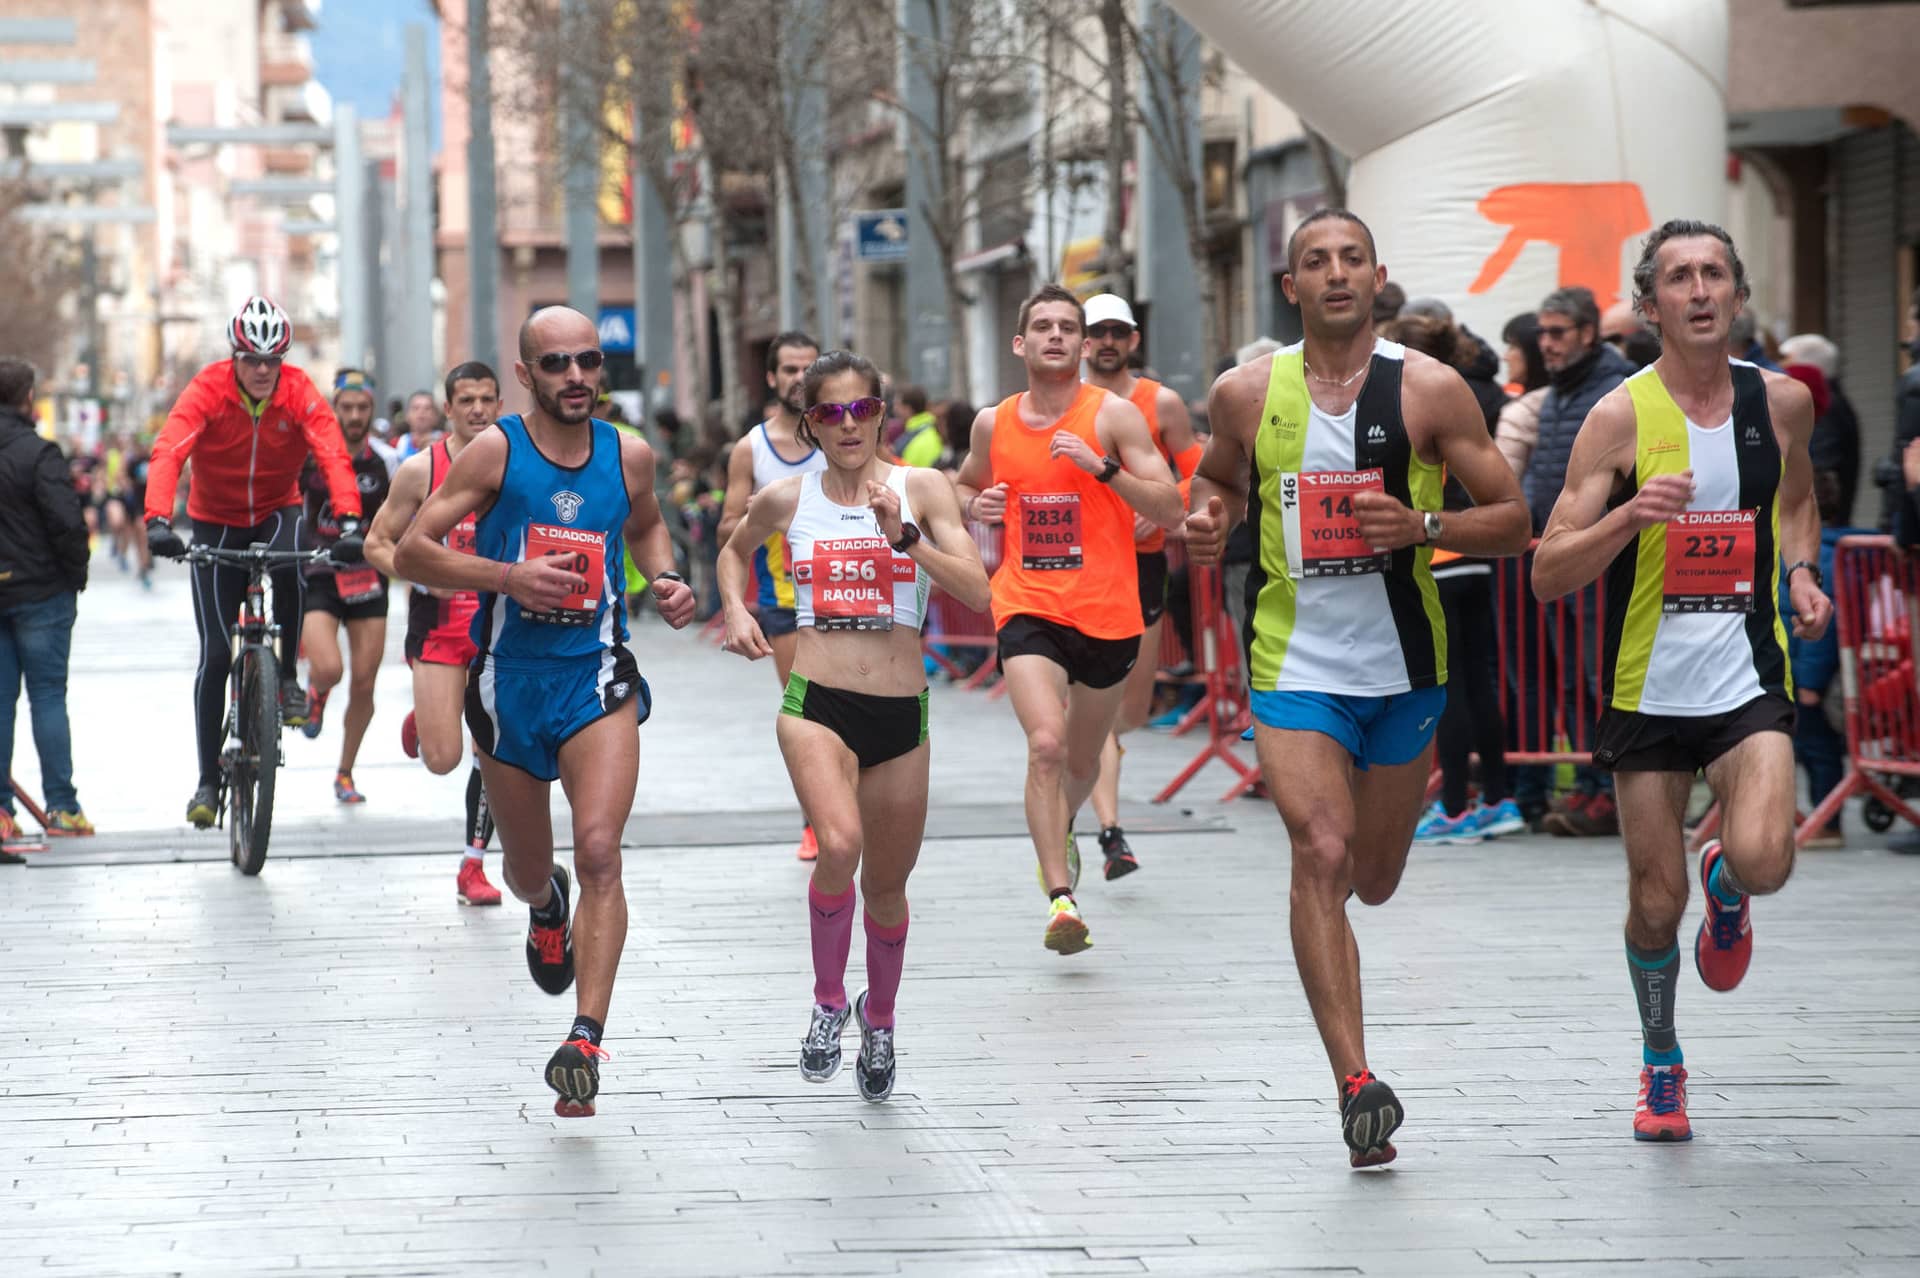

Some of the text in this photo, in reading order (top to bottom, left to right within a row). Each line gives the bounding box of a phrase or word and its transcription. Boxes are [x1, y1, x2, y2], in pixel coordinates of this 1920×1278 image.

[1319, 472, 1382, 485] DIADORA
[1031, 495, 1080, 504] DIADORA
[1283, 477, 1297, 509] 146
[1319, 495, 1354, 519] 14
[1026, 509, 1073, 526] 2834
[1688, 512, 1754, 525] DIADORA
[548, 528, 603, 545] DIADORA
[1027, 532, 1074, 544] PABLO
[1311, 527, 1364, 541] YOUSS
[831, 539, 891, 551] DIADORA
[1683, 535, 1736, 558] 237
[828, 559, 877, 582] 356
[1675, 567, 1742, 577] VICTOR MANUEL
[822, 588, 884, 602] RAQUEL
